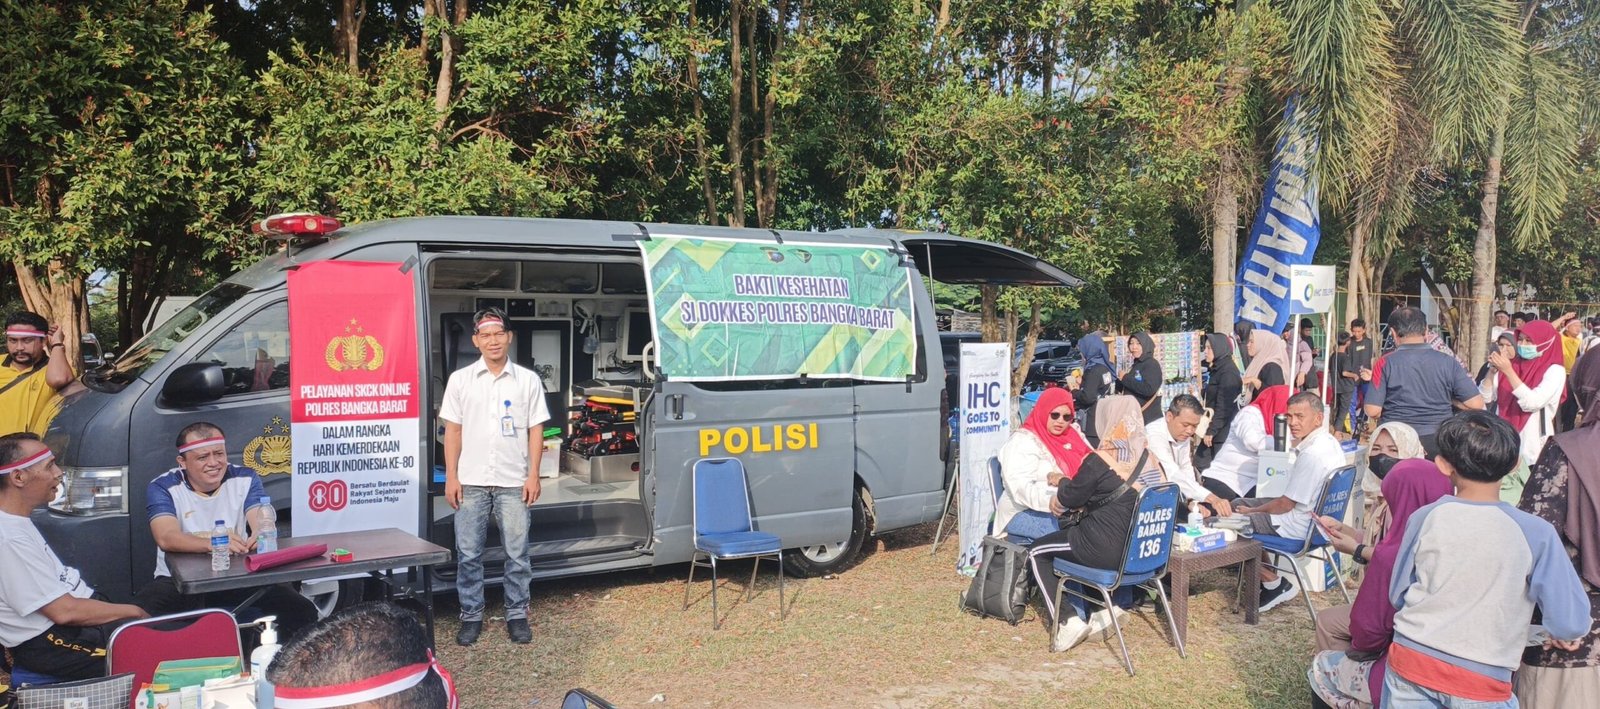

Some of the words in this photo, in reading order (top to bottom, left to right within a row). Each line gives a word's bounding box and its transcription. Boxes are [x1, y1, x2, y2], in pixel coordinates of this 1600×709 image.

[1239, 112, 1317, 327] MAHA
[734, 274, 775, 295] BAKTI
[778, 276, 849, 298] KESEHATAN
[680, 301, 695, 323] SI
[699, 302, 754, 322] DOKKES
[758, 302, 807, 323] POLRES
[811, 304, 858, 326] BANGKA
[859, 308, 895, 329] BARAT
[301, 384, 354, 399] PELAYANAN
[355, 383, 379, 397] SKCK
[380, 382, 411, 397] ONLINE
[967, 381, 1001, 410] IHC
[305, 401, 341, 416] POLRES
[341, 400, 379, 415] BANGKA
[379, 399, 408, 414] BARAT
[966, 412, 989, 424] GOES
[990, 411, 1001, 422] TO
[322, 426, 355, 440] DALAM
[355, 424, 392, 438] RANGKA
[966, 424, 1001, 435] COMMUNITY
[698, 422, 819, 456] POLISI
[313, 443, 335, 457] HARI
[336, 440, 400, 456] KEMERDEKAAN
[297, 460, 341, 475] REPUBLIK
[341, 457, 388, 473] INDONESIA
[389, 455, 414, 470] KE-80
[350, 482, 377, 490] Bersatu
[377, 479, 410, 488] Berdaulat
[350, 489, 373, 498] Rakyat
[374, 487, 406, 497] Sejahtera
[308, 479, 348, 512] 80
[383, 496, 399, 504] Maju
[1137, 508, 1172, 525] POLRES
[1137, 522, 1166, 538] BABAR
[1139, 538, 1161, 559] 136
